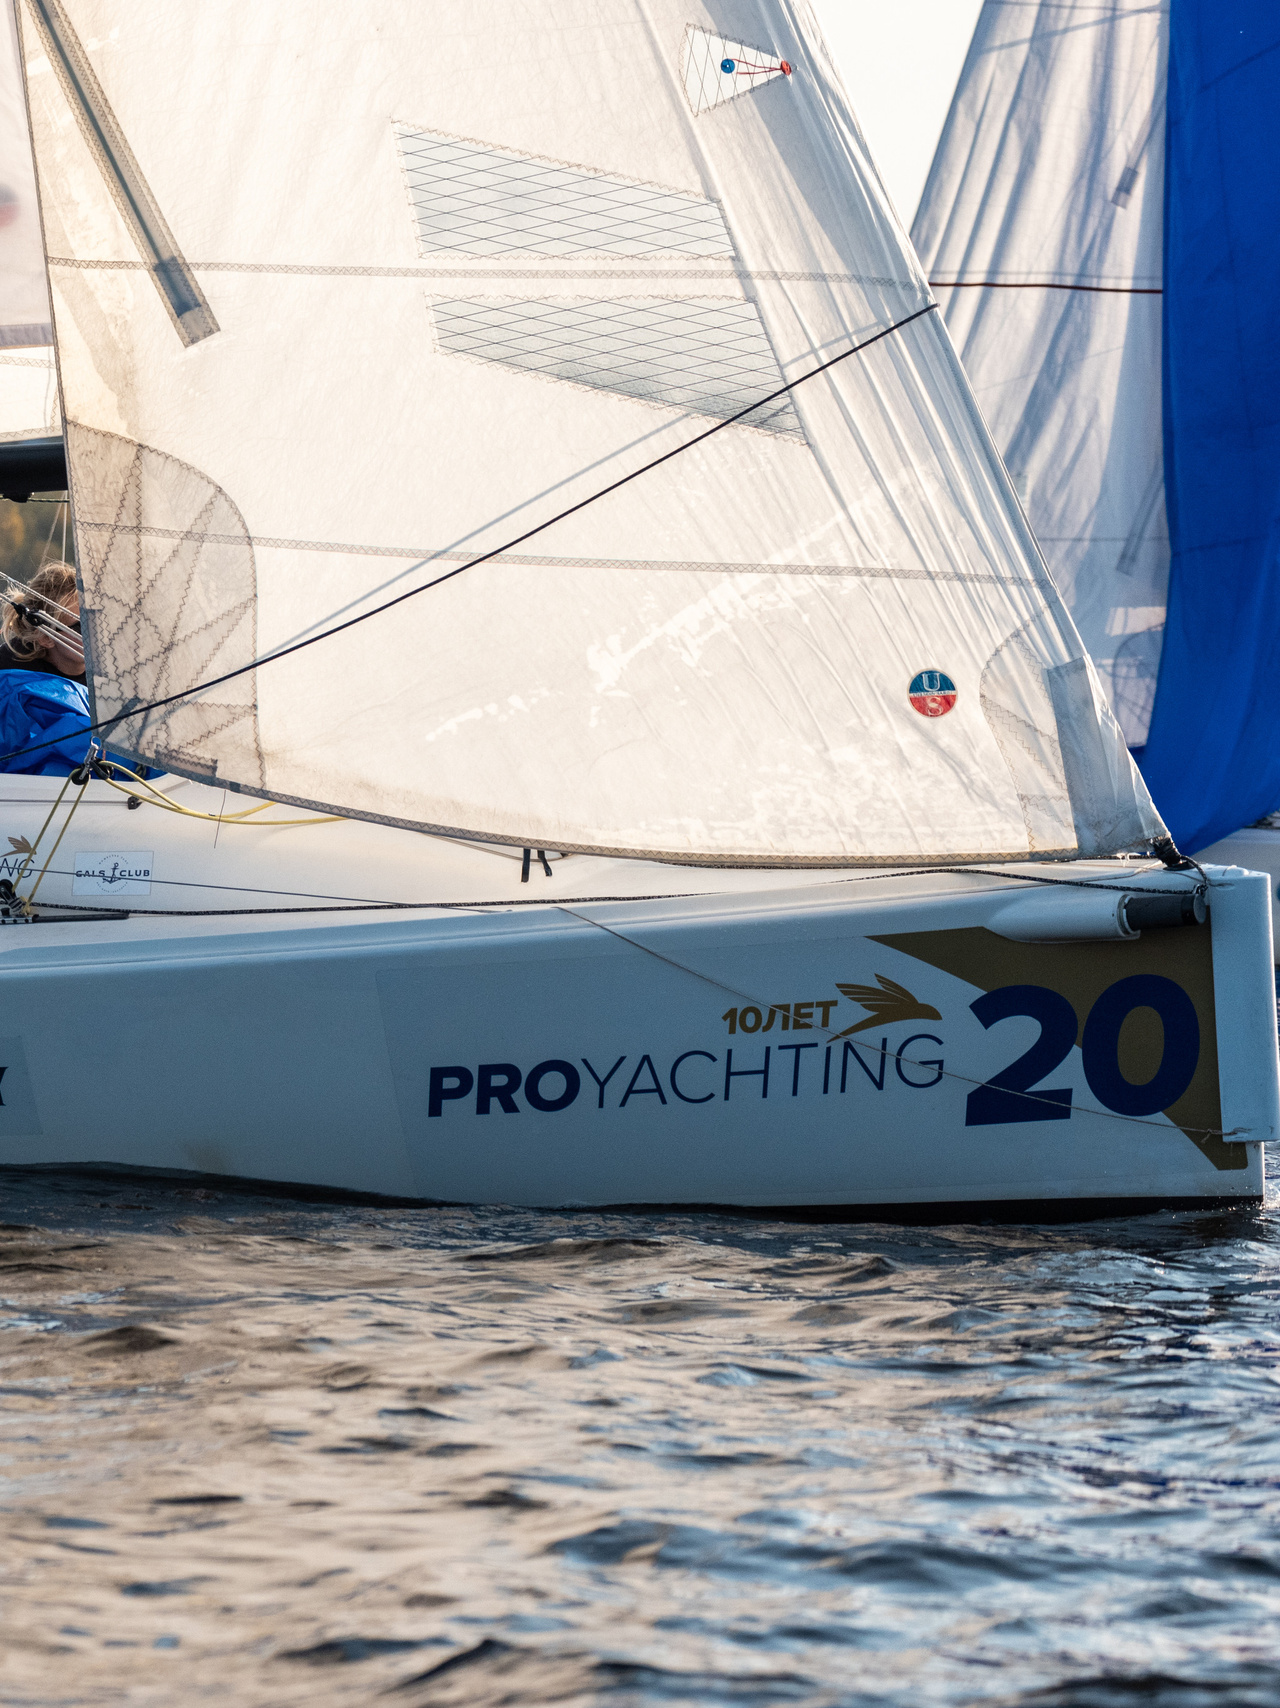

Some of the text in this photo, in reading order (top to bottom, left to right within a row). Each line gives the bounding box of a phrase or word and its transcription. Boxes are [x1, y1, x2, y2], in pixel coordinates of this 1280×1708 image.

[119, 869, 150, 877] CLUB
[428, 1033, 945, 1118] PROYACHTING
[965, 974, 1201, 1127] 20
